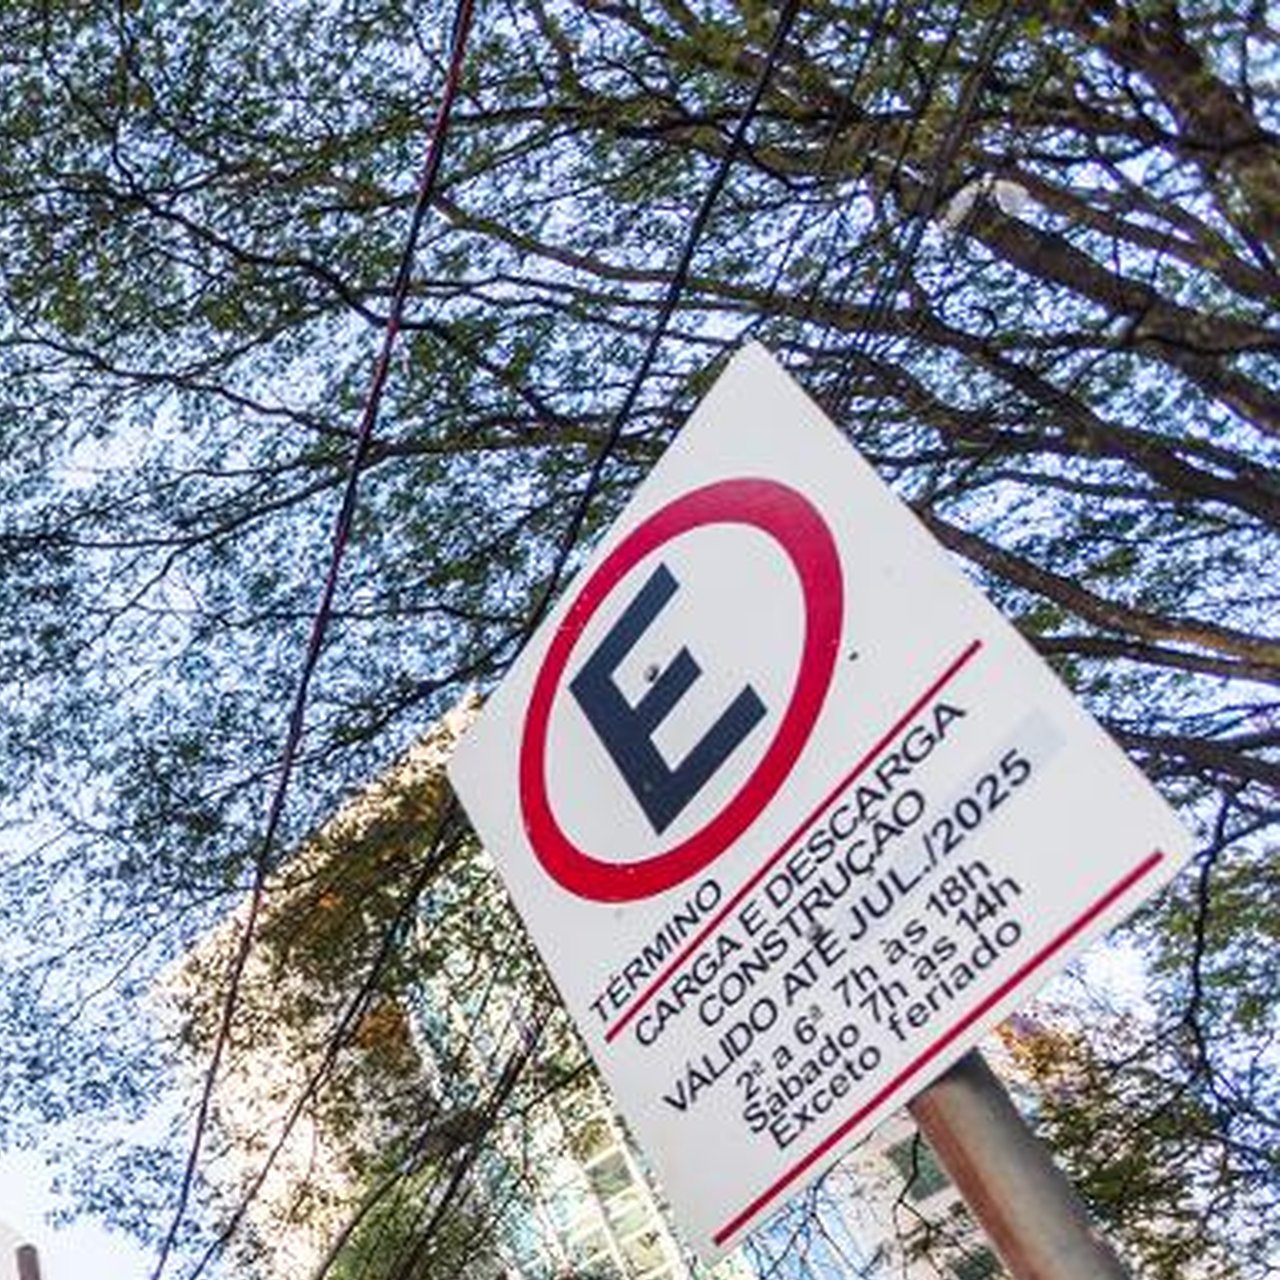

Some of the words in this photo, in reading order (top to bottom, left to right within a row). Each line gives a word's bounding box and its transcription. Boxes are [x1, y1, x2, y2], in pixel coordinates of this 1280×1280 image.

[568, 561, 768, 836] E
[590, 879, 722, 1021] TÉRMINO
[636, 935, 744, 1047] CARGA
[738, 899, 769, 937] E
[764, 703, 967, 908] DESCARGA
[662, 997, 778, 1112] VÁLIDO
[849, 748, 1032, 942] JUL./2025
[699, 788, 925, 1027] CONSTRUÇÃO
[772, 1045, 794, 1071] a
[832, 964, 879, 1008] 7h
[879, 918, 928, 965] às
[926, 860, 991, 918] 18h
[742, 1023, 860, 1134] Sábado
[859, 980, 910, 1023] 7h
[909, 935, 958, 981] às
[956, 877, 1022, 934] 14h
[768, 1045, 881, 1151] Exceto
[888, 920, 1022, 1042] feriado
